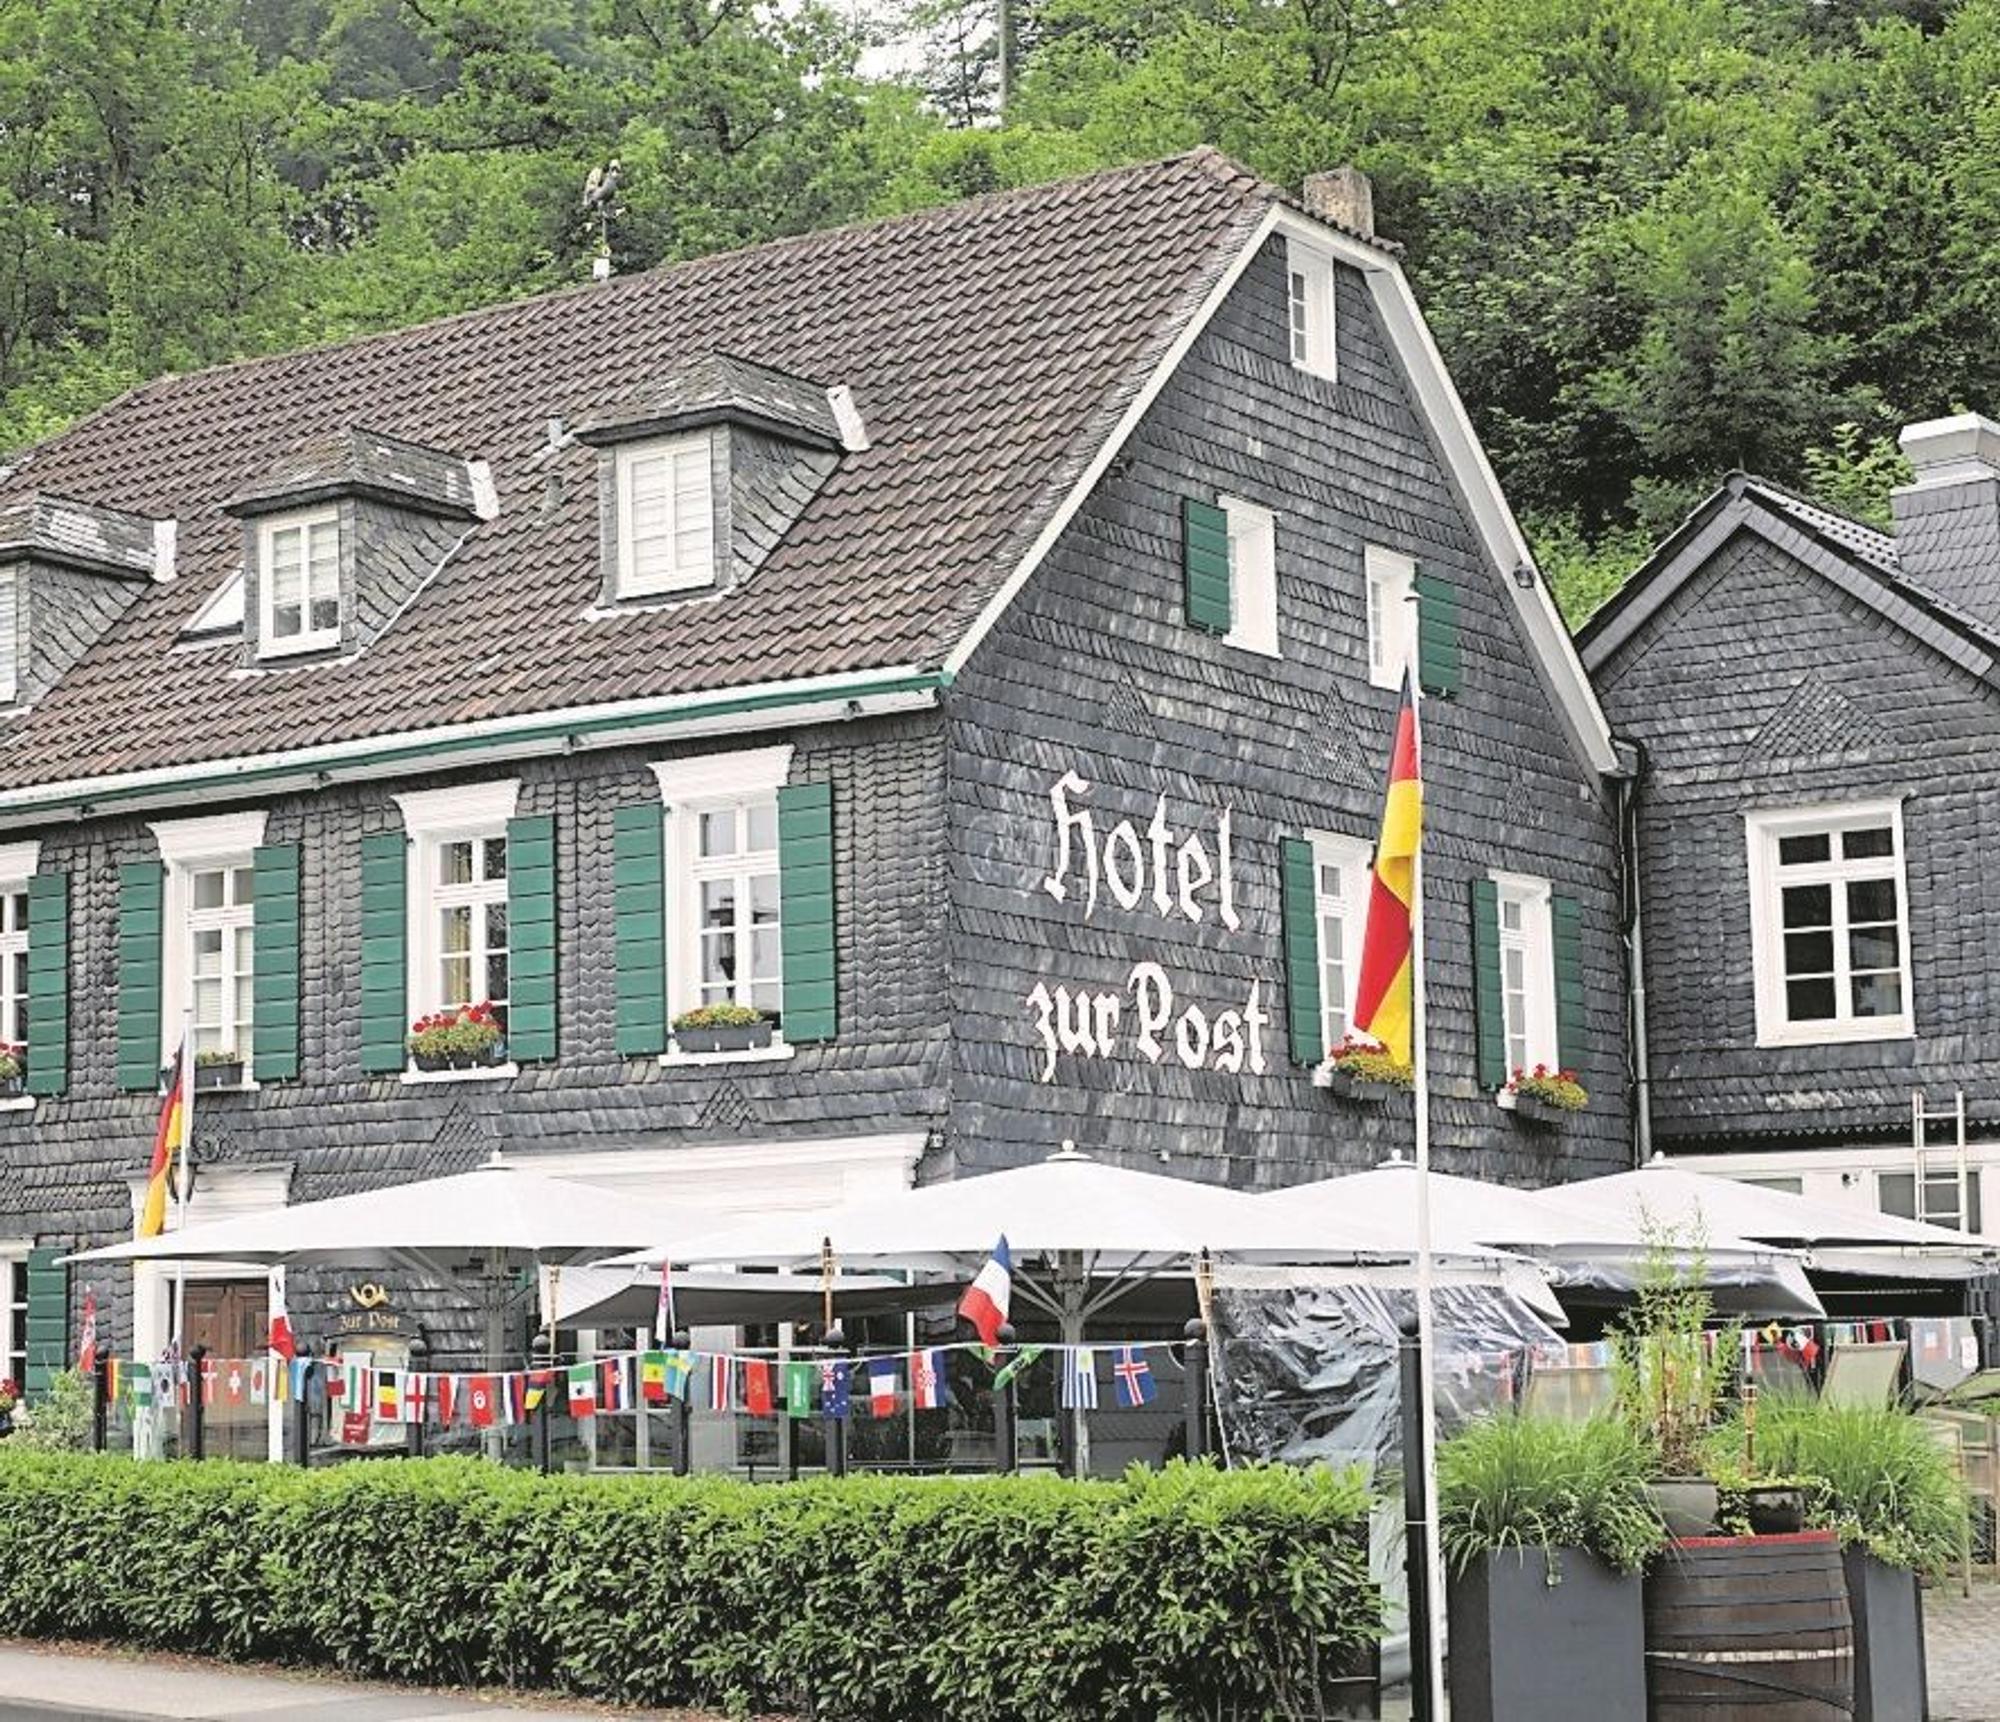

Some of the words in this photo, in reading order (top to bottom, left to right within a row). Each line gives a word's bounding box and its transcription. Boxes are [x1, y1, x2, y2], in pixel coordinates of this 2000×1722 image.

[1044, 769, 1241, 933] Hotel
[1026, 981, 1120, 1083] zur
[1127, 961, 1269, 1075] Post
